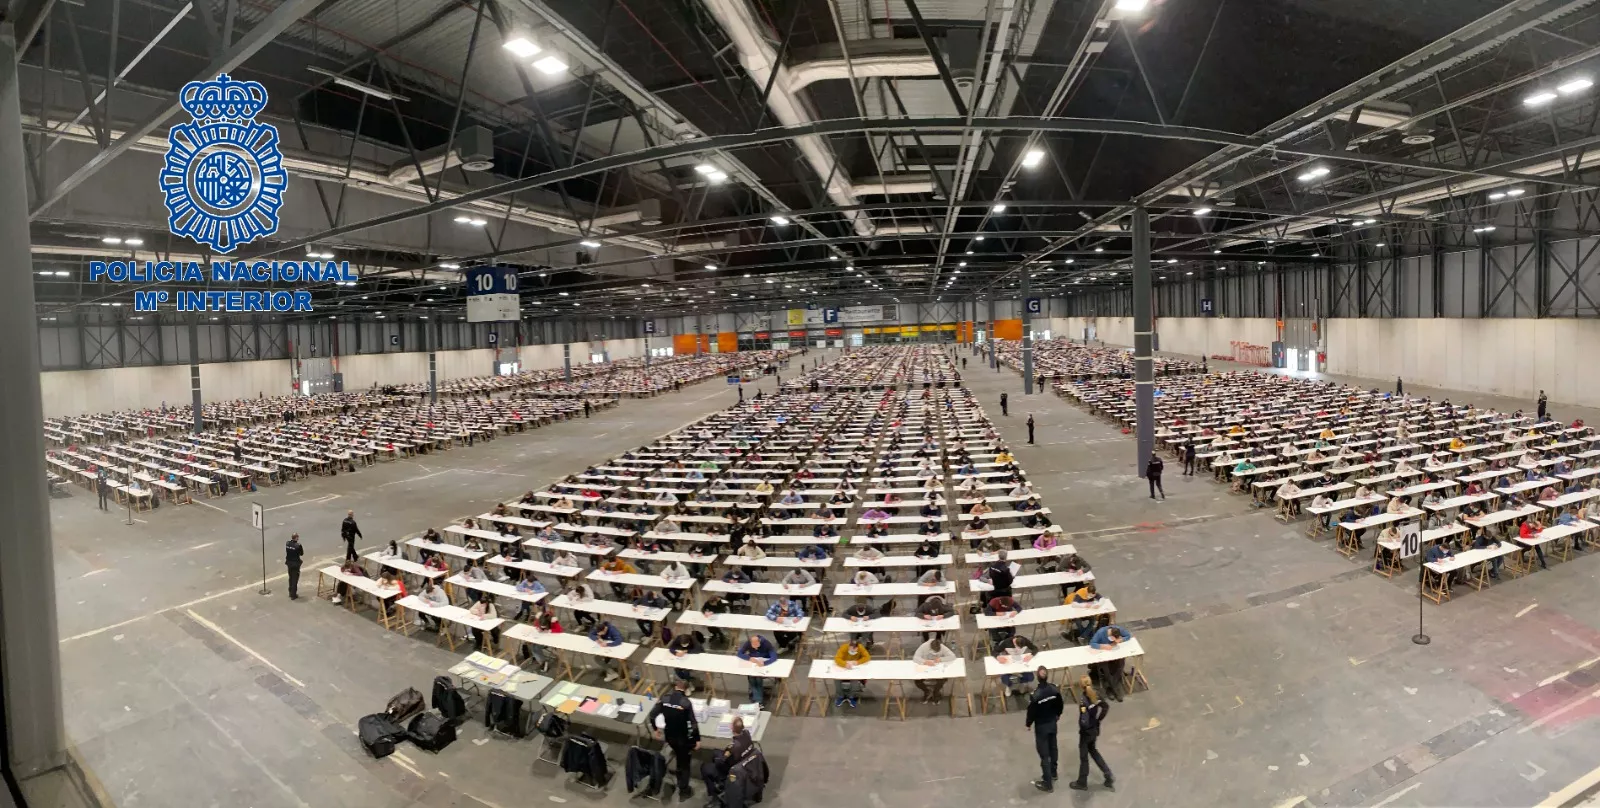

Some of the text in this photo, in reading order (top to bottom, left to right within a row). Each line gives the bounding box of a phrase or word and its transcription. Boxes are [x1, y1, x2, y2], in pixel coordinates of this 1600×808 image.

[475, 273, 493, 291] 10
[504, 273, 517, 290] 10
[1028, 300, 1039, 311] G
[1202, 301, 1212, 311] H
[827, 309, 835, 320] F
[645, 321, 653, 331] E
[391, 336, 398, 345] C
[489, 333, 497, 343] D
[1402, 532, 1418, 557] 10
